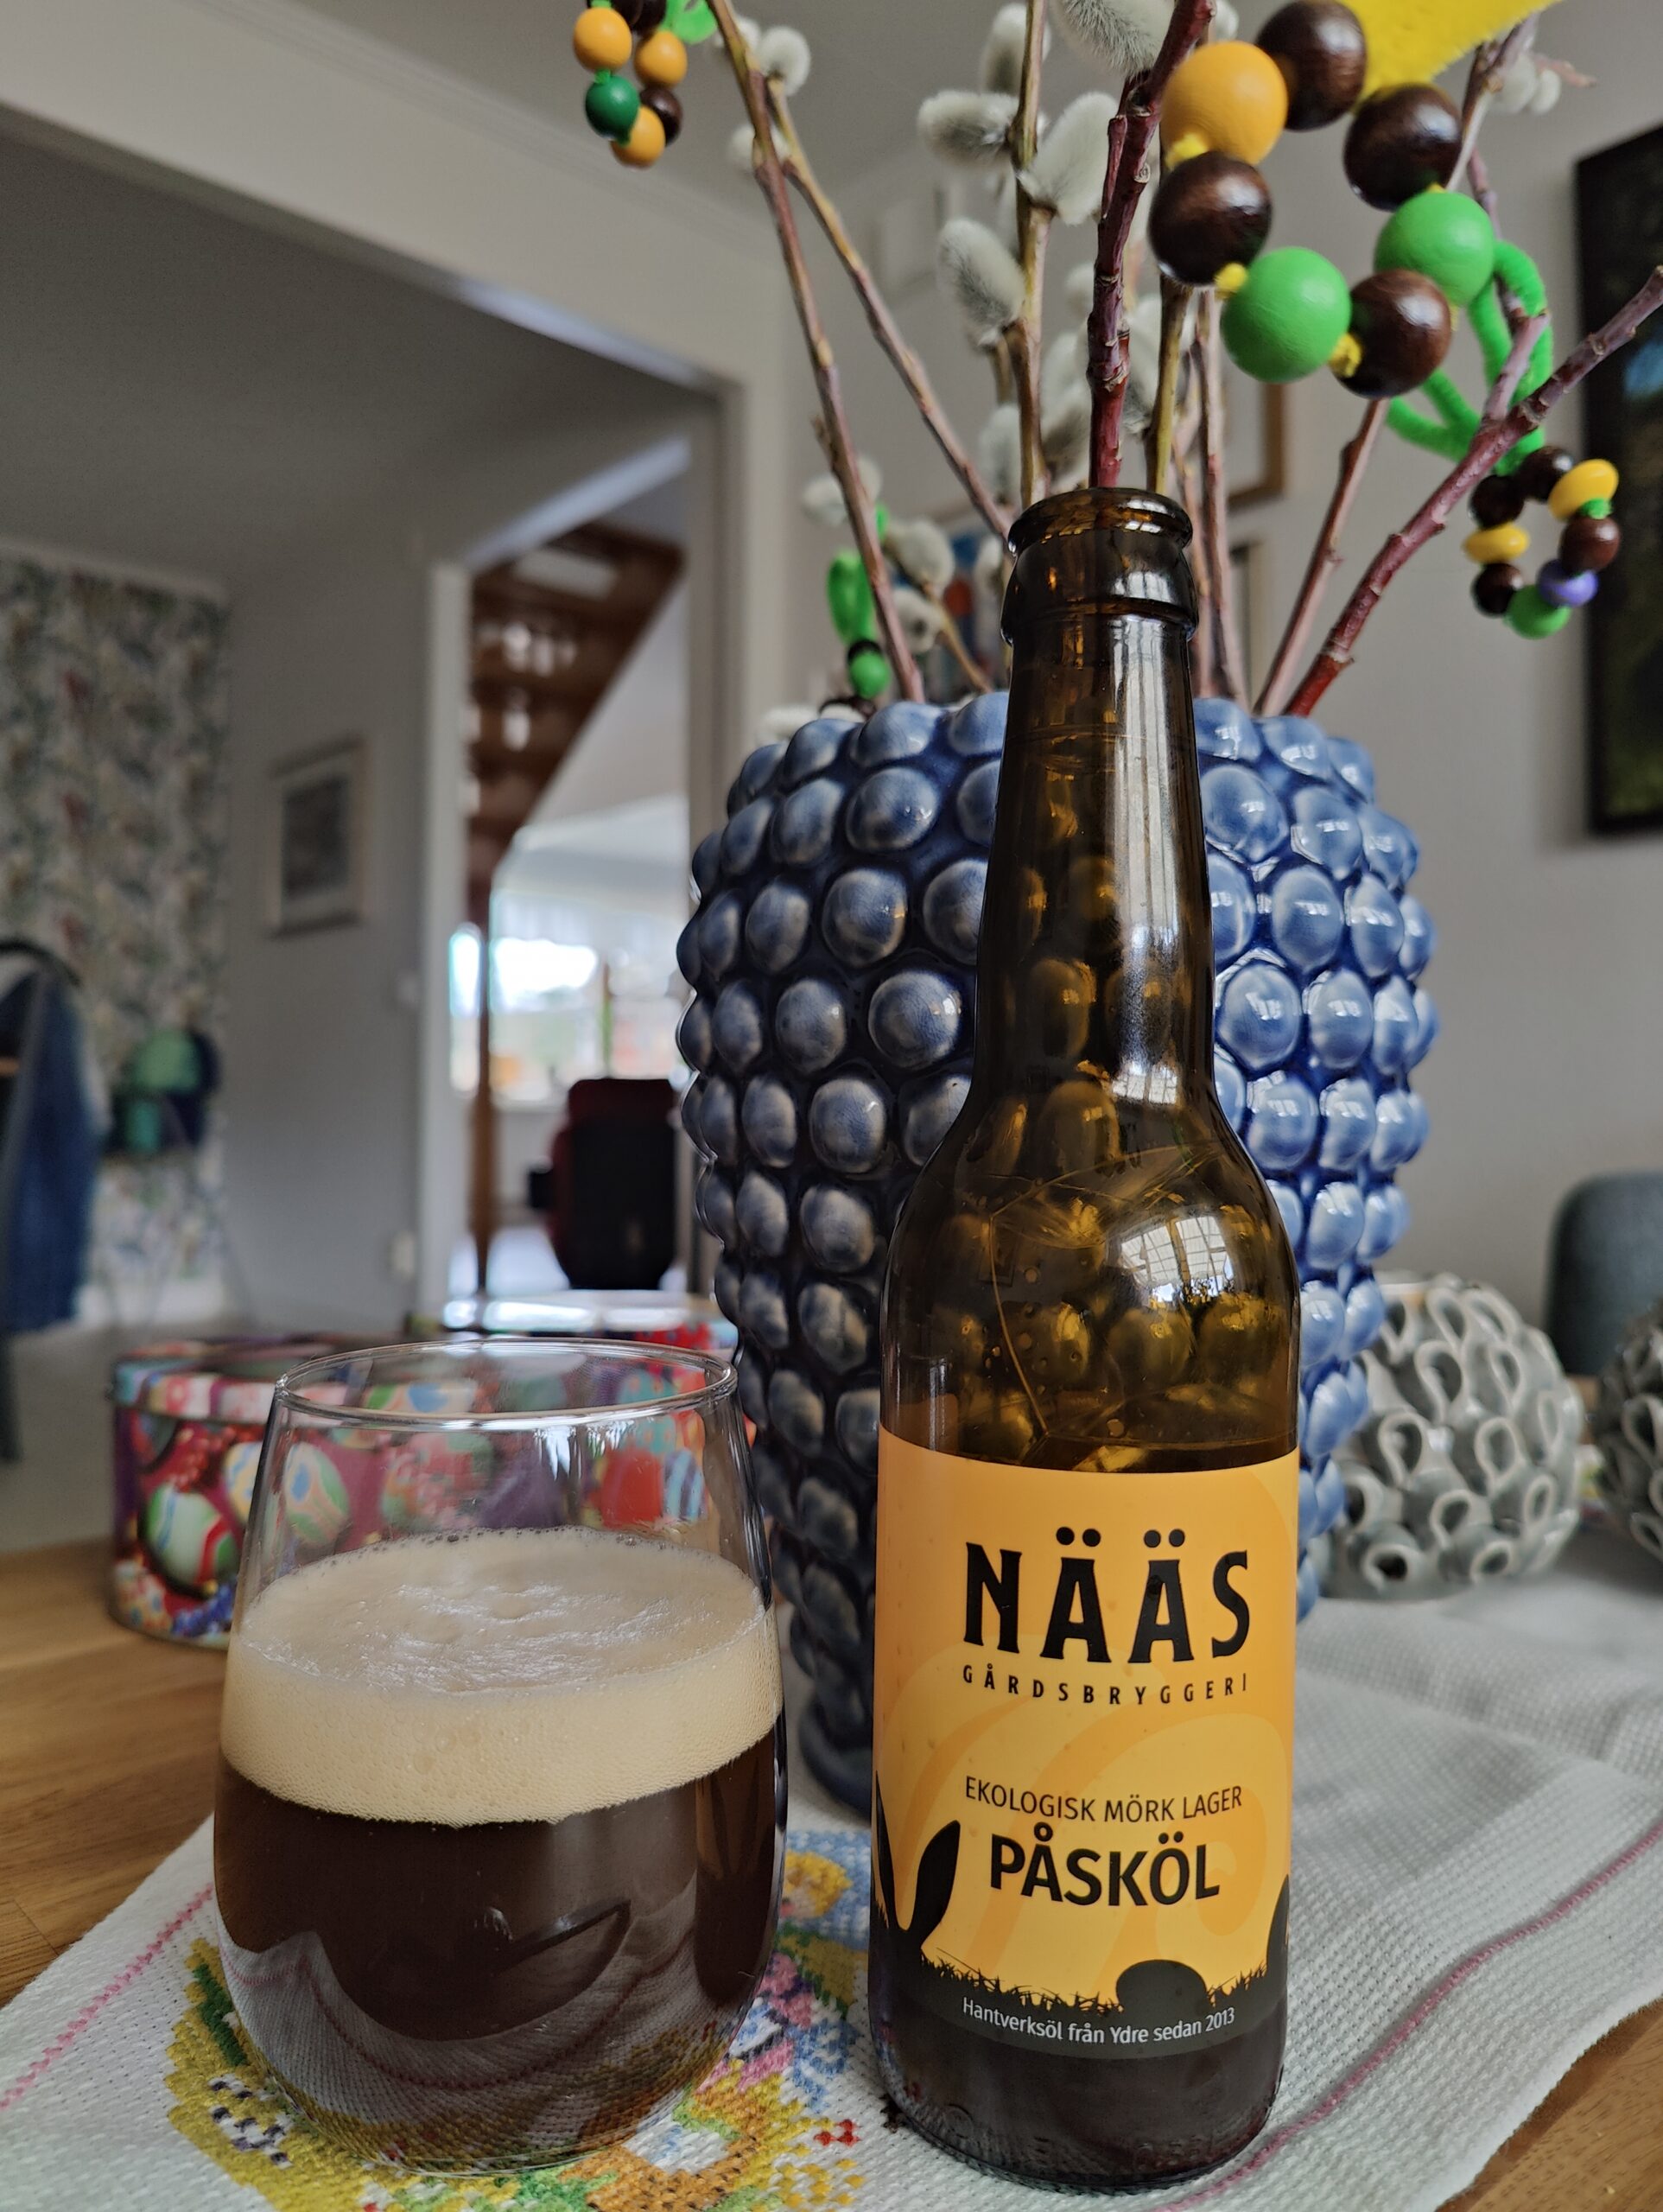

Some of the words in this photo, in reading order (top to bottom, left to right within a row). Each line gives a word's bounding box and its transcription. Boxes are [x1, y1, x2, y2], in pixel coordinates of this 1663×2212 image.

[963, 1527, 1250, 1663] NÄÄS
[963, 1663, 1247, 1705] GÅRDSBRYGGERI
[966, 1776, 1095, 1821] EKOLOGISK
[1105, 1795, 1174, 1822] MÖRK
[1183, 1785, 1242, 1819] LAGER
[990, 1821, 1220, 1906] PÅSKÖL
[962, 1997, 1063, 2040] Hantverksöl
[1068, 2023, 1105, 2044] från
[1110, 2026, 1149, 2044] Ydre
[1153, 2019, 1202, 2041] sedan
[1205, 2007, 1235, 2032] 2013
